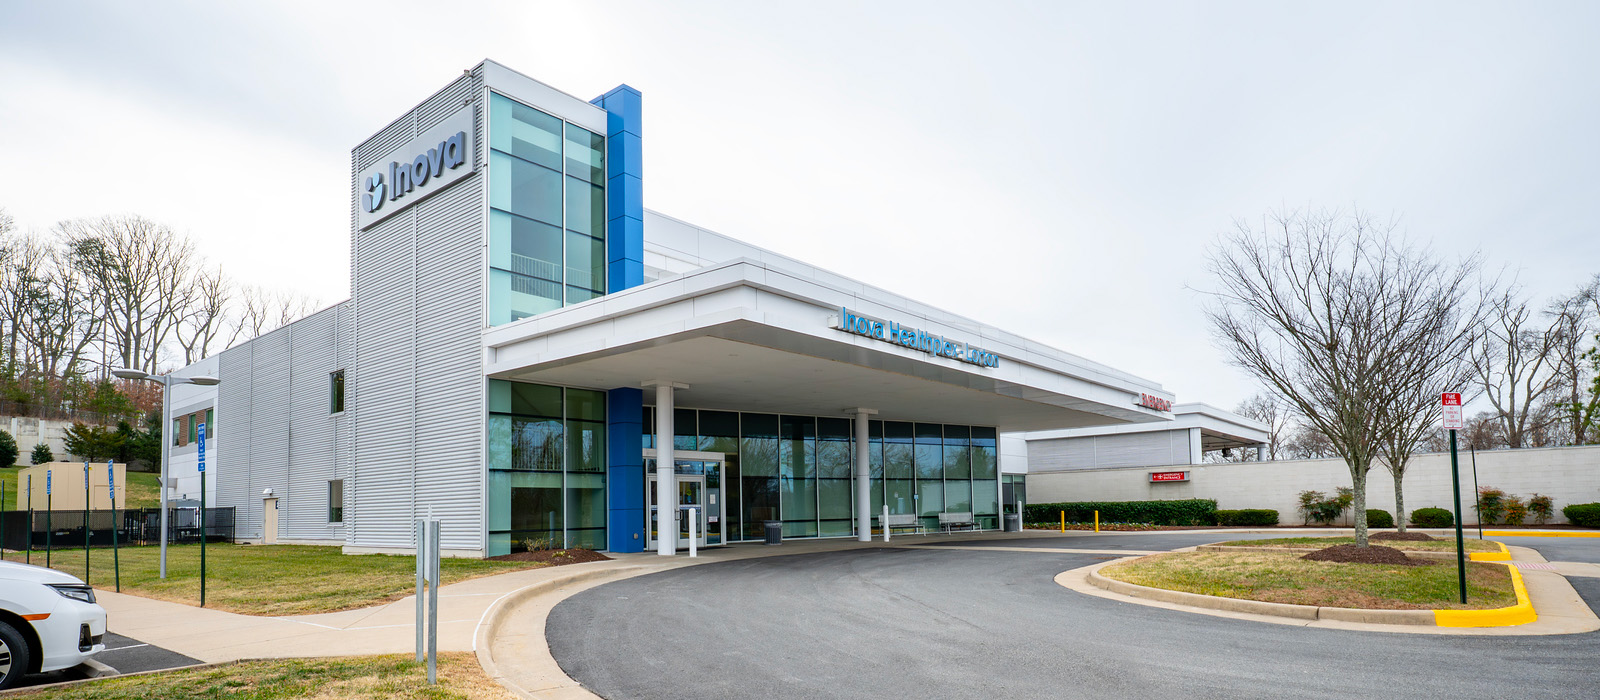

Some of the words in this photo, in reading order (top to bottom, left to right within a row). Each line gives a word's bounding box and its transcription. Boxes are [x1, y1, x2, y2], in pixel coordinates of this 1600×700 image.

[389, 131, 466, 201] Inova
[842, 306, 884, 338] Inova
[889, 320, 959, 358] Healthplex
[965, 342, 1000, 368] Lorton
